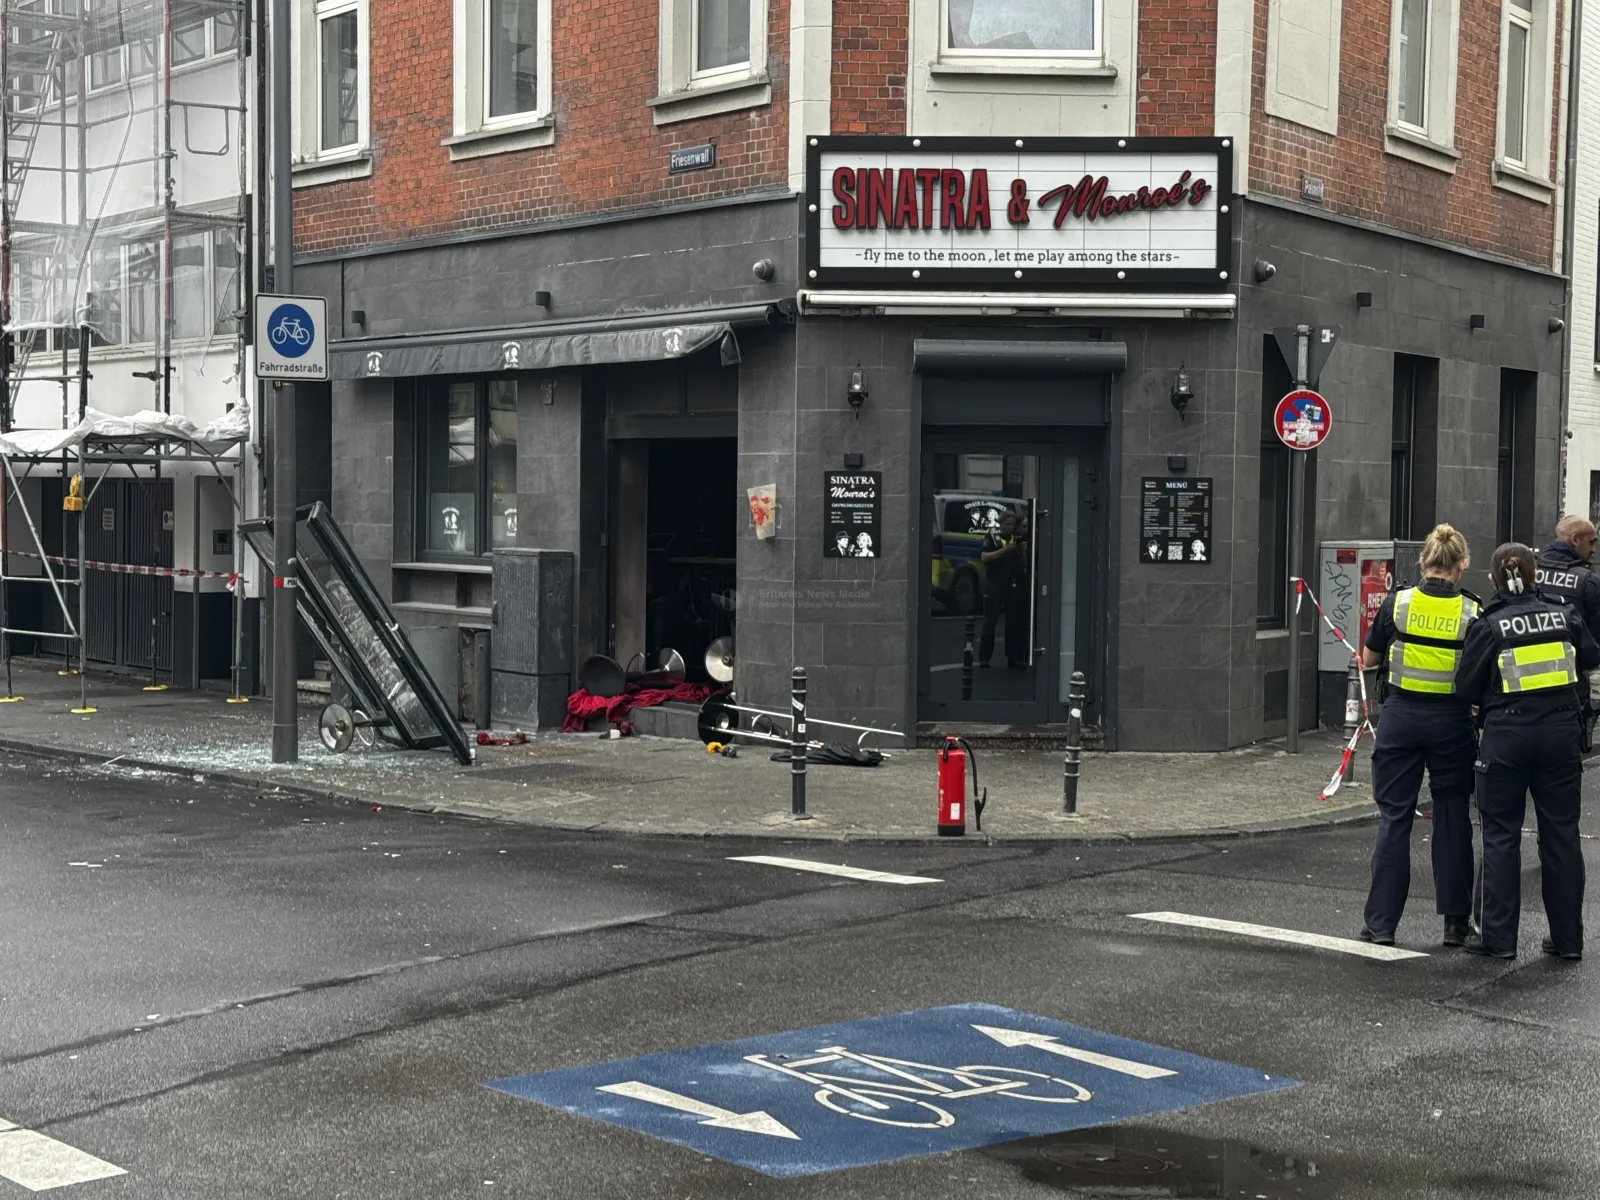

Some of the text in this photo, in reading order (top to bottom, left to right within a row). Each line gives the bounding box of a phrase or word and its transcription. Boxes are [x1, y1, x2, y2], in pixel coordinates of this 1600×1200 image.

[671, 149, 709, 168] Friesenwall
[832, 167, 1212, 229] SINATRA & Monroe's
[884, 251, 904, 261] me
[908, 251, 920, 261] to
[924, 249, 944, 261] the
[1014, 252, 1034, 262] me
[1038, 250, 1064, 264] play
[1068, 252, 1112, 264] among
[1116, 250, 1137, 262] the
[260, 362, 323, 373] Fahrradstraße
[830, 476, 875, 484] SINATRA
[830, 486, 875, 498] Monroe's
[1534, 569, 1578, 589] OLIZEI
[1408, 613, 1458, 633] POLIZEI
[1499, 611, 1567, 637] POLIZEI
